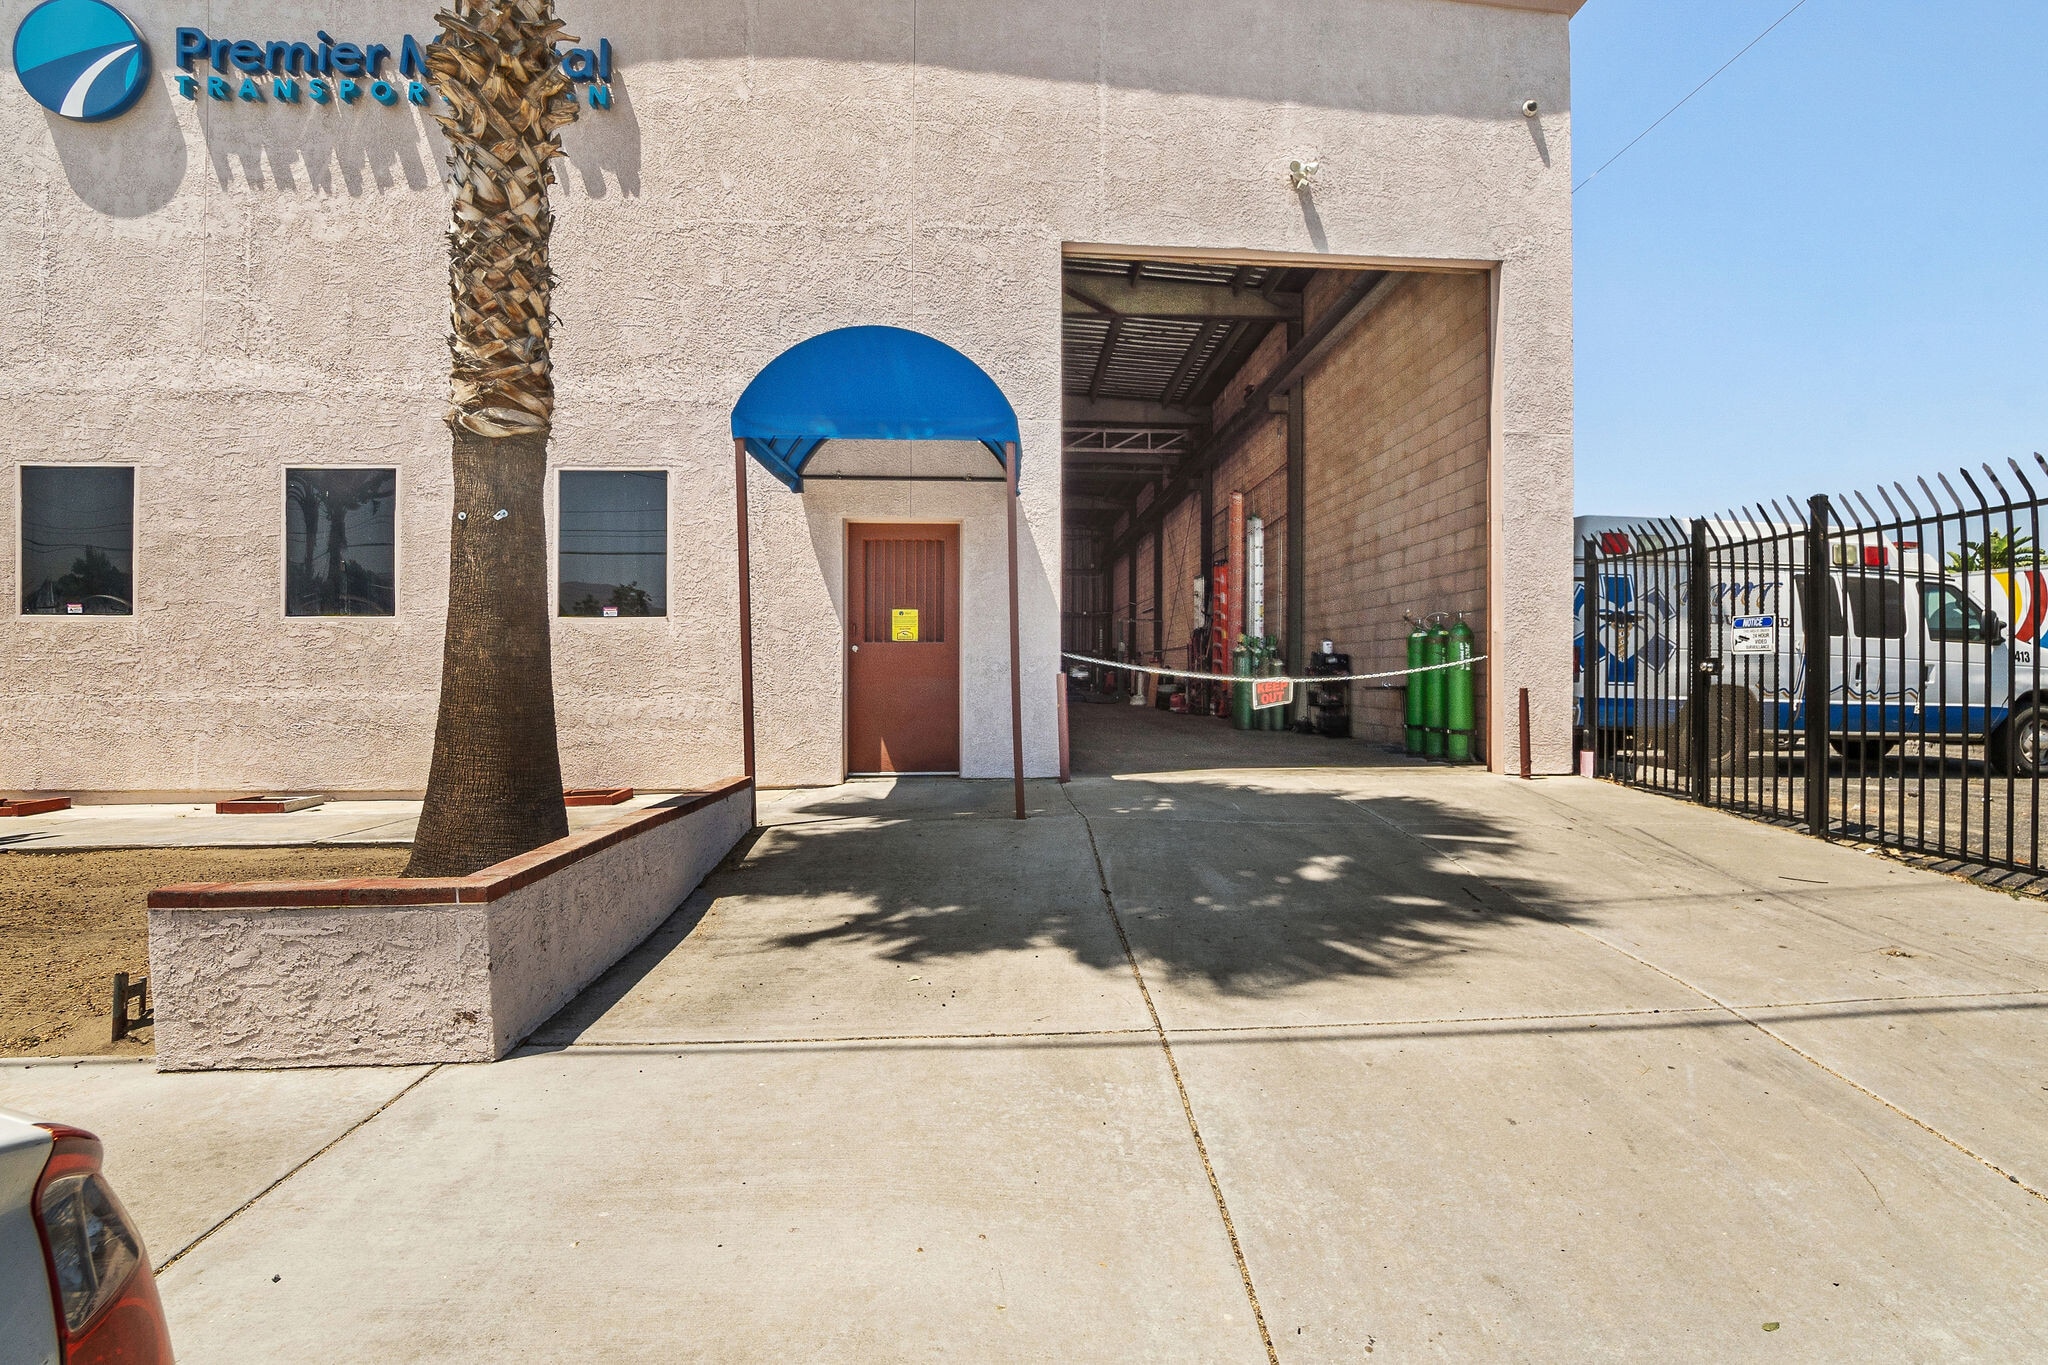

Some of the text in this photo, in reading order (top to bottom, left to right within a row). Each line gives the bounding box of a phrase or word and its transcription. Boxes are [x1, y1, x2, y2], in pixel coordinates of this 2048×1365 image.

[176, 27, 390, 79] Premier
[1742, 617, 1764, 628] NOTICE
[1257, 681, 1288, 694] KEEP
[1261, 690, 1284, 705] OUT
